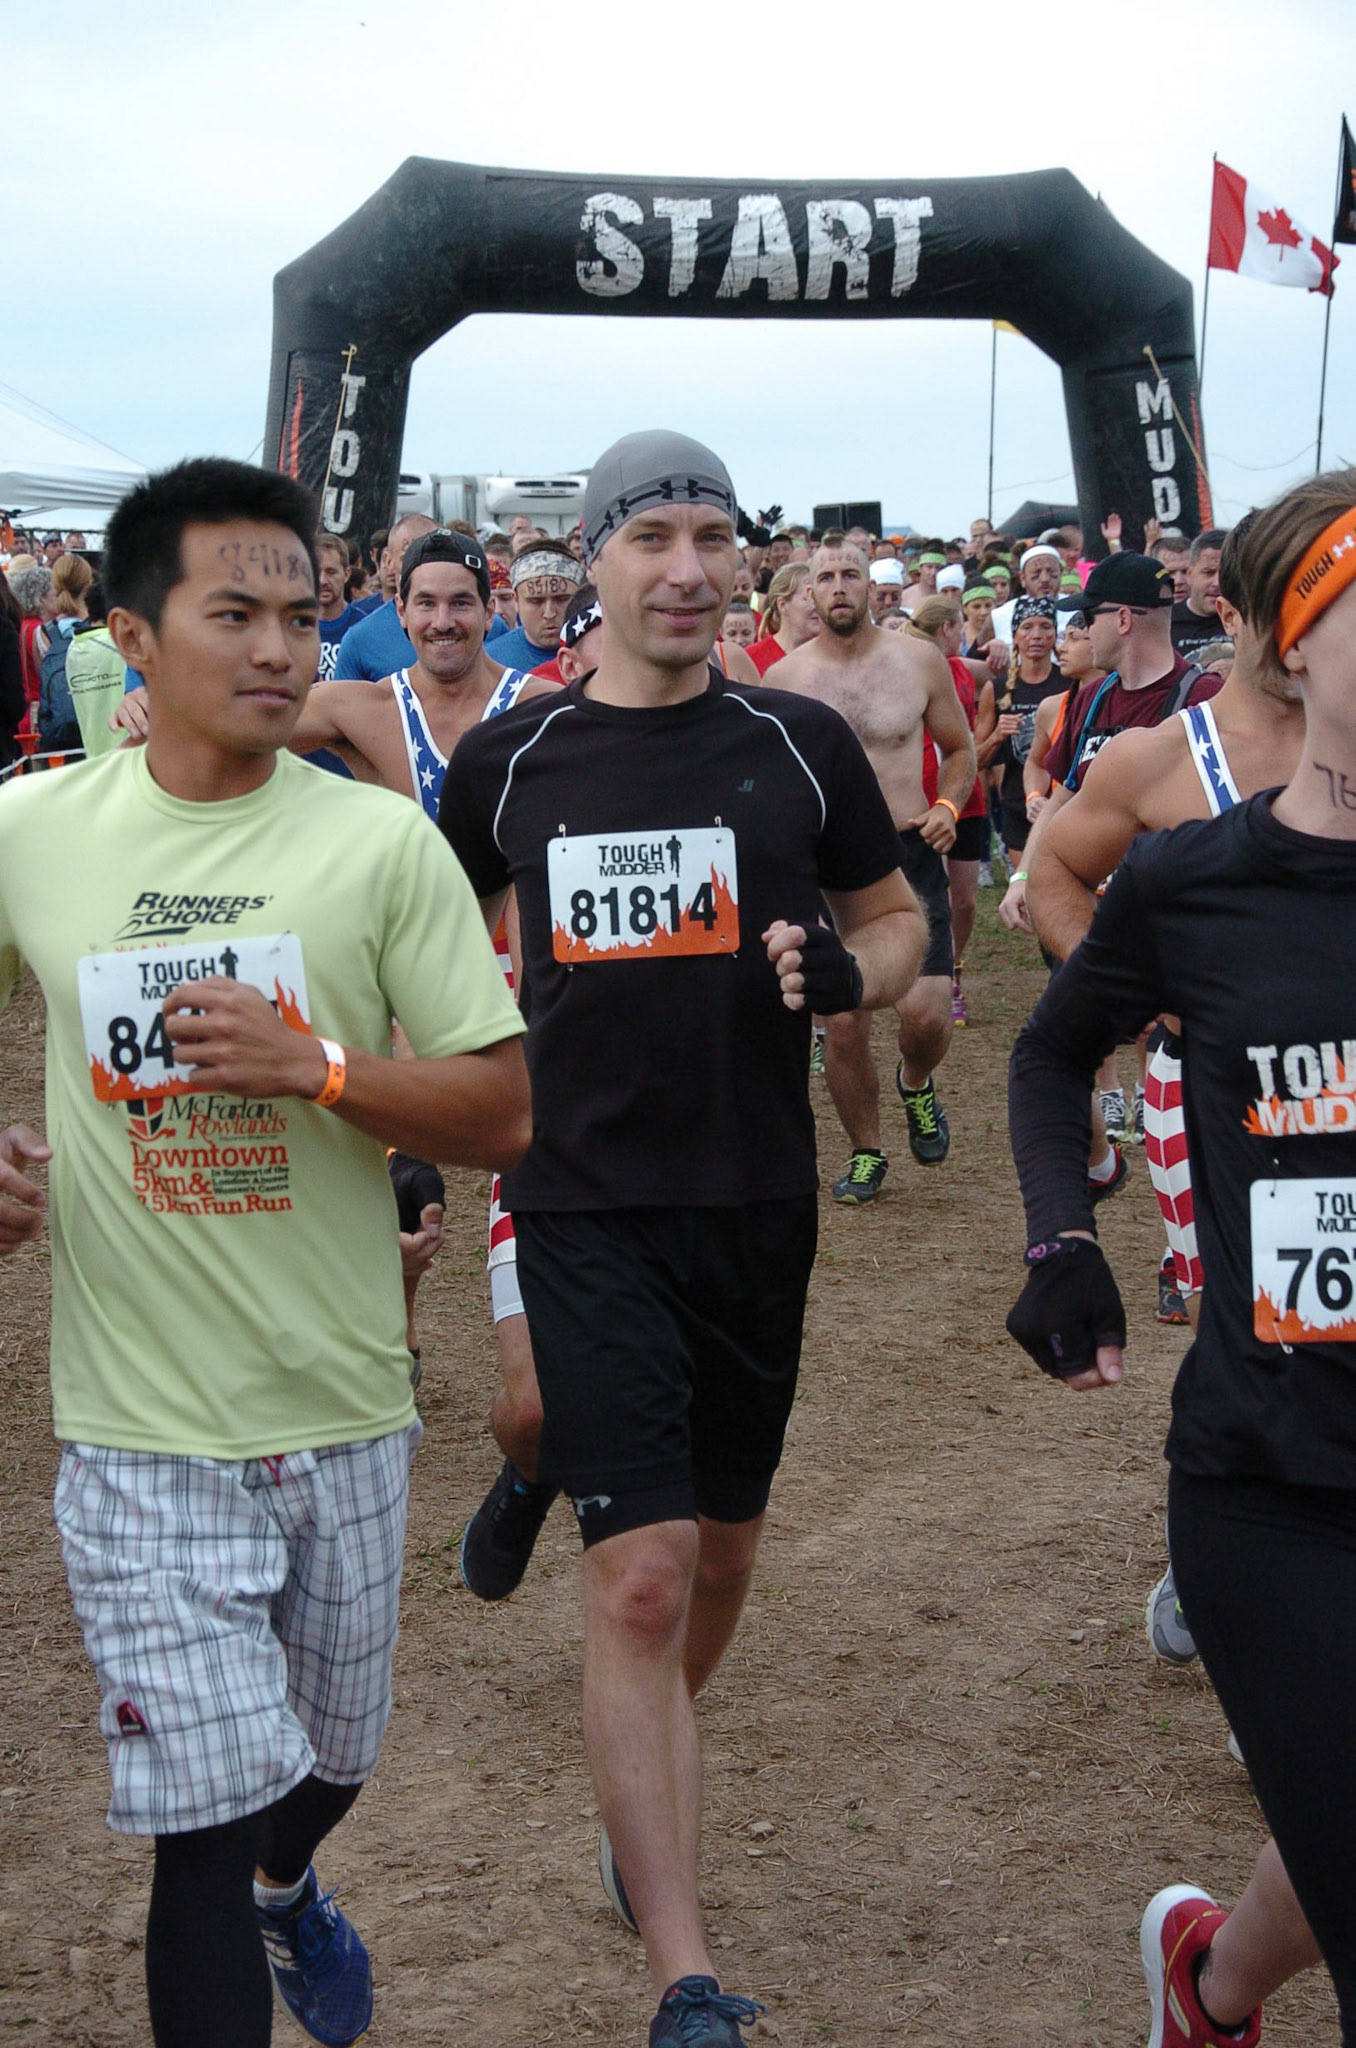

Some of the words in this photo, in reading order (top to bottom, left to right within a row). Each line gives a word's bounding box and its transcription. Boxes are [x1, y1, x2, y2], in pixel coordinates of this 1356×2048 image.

[575, 192, 934, 301] START
[1135, 378, 1182, 537] MUD
[1295, 551, 1335, 600] TOUGH
[598, 843, 663, 864] TOUGH
[599, 861, 666, 878] MUDDER
[144, 910, 243, 924] CHOICE
[570, 881, 718, 939] 81814
[138, 957, 216, 985] TOUGH
[168, 1095, 273, 1121] McFarlan
[187, 1111, 288, 1141] Rowlands
[131, 1140, 288, 1168] Downtown
[244, 1193, 292, 1213] Run
[1277, 1247, 1356, 1312] 76
